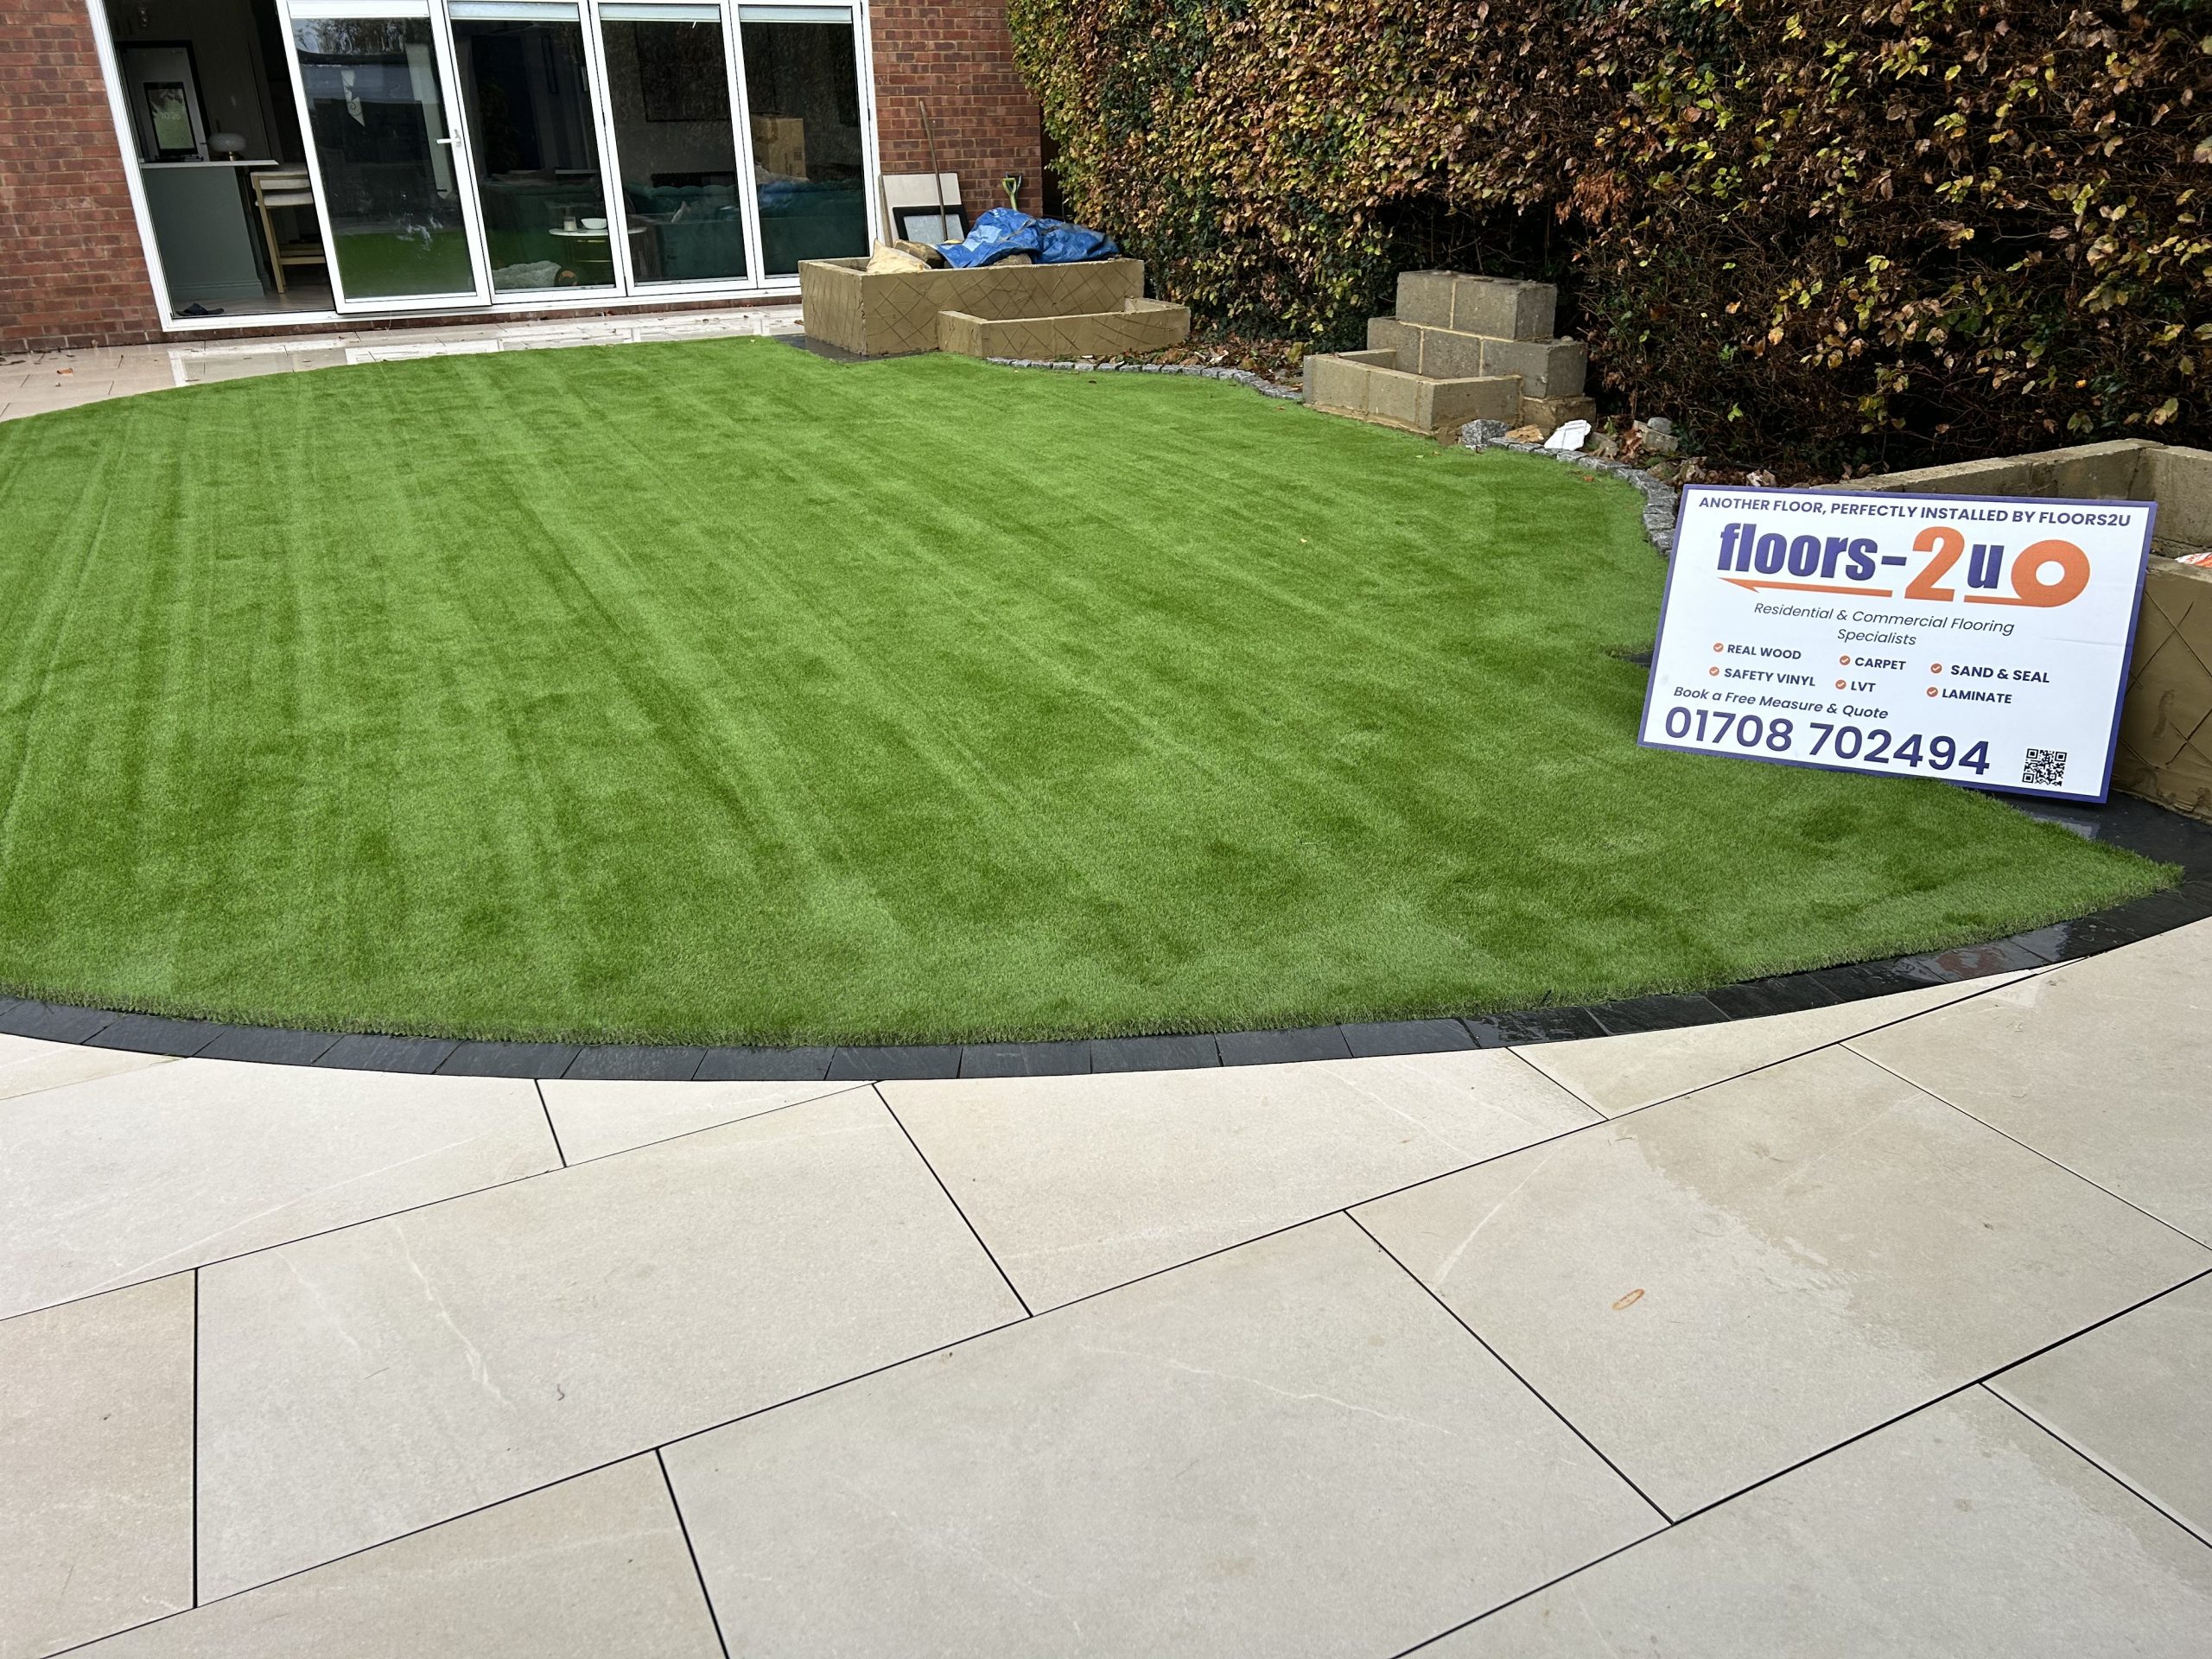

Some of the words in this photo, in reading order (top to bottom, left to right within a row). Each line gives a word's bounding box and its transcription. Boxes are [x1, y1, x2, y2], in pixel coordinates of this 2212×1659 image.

[1699, 498, 1770, 511] ANOTHER
[1773, 501, 1827, 516] FLOOR,
[1831, 503, 1917, 518] PERFECTLY
[1920, 507, 2008, 522] INSTALLED
[2012, 511, 2037, 523] BY
[2038, 512, 2131, 527] FLOORS2U
[1754, 603, 1834, 620] Residential
[1836, 610, 1848, 621] &
[1852, 611, 1948, 628] Commercial
[1950, 619, 2015, 637] Flooring
[1837, 629, 1916, 645] Specialists
[1727, 645, 1758, 656] REAL
[1760, 647, 1802, 660] WOOD
[1854, 658, 1907, 671] CARPET
[1724, 669, 1774, 683] SAFETY
[1777, 674, 1815, 687] VINYL
[1950, 665, 1993, 678] SAND
[1996, 669, 2009, 680] &
[2012, 671, 2050, 683] SEAL
[1850, 682, 1877, 693] LVT
[1942, 689, 2012, 704] LAMINATE
[1673, 687, 1709, 700] Book
[1713, 693, 1722, 702] a
[1725, 692, 1757, 705] Free
[1758, 696, 1823, 712] Measure
[1826, 703, 1838, 715] &
[1842, 705, 1889, 720] Quote
[1664, 707, 1794, 753] 01708
[1808, 722, 1991, 776] 702494
